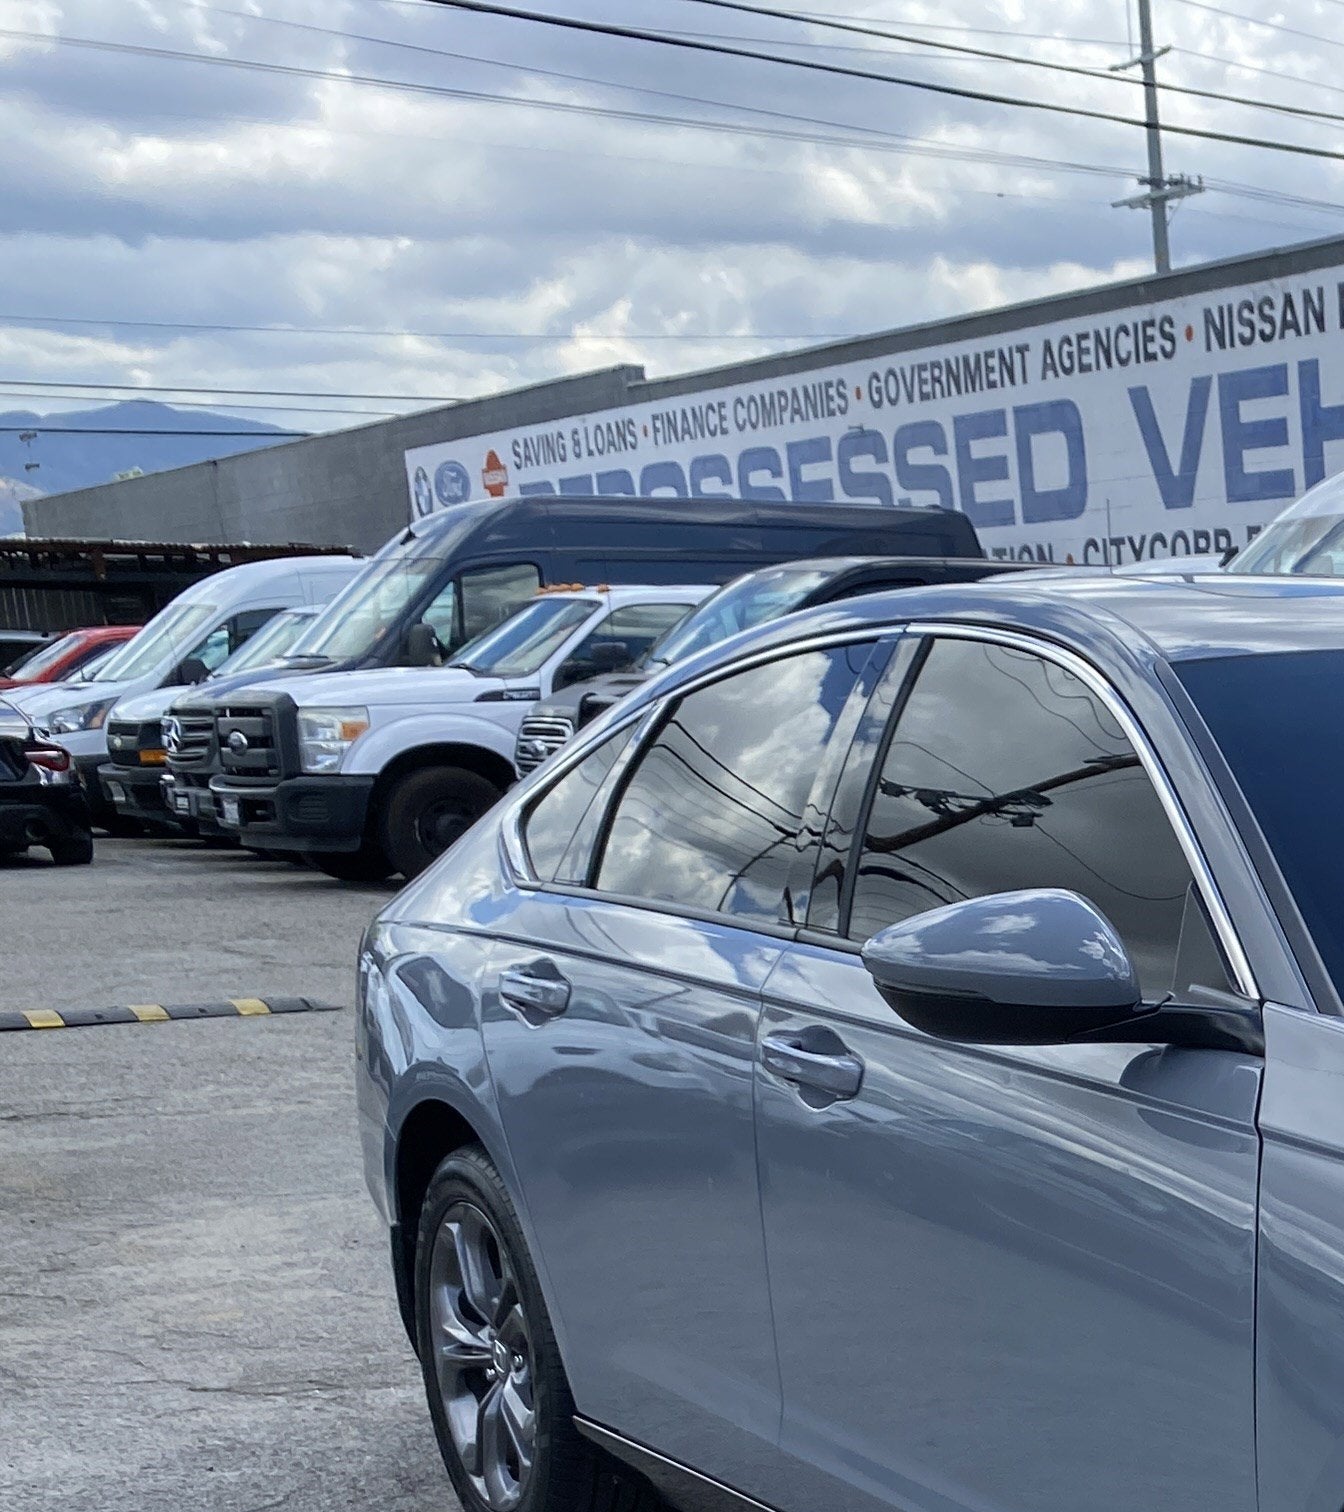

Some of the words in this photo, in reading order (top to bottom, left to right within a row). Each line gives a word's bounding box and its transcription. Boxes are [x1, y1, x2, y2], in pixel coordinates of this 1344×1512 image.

[1203, 287, 1326, 352] NISSAN
[868, 342, 1029, 409] GOVERNMENT
[1041, 315, 1177, 380] AGENCIES
[511, 429, 567, 470] SAVING
[571, 428, 582, 459] &
[587, 418, 637, 456] LOANS
[651, 401, 729, 446] FINANCE
[733, 379, 849, 431] COMPANIES
